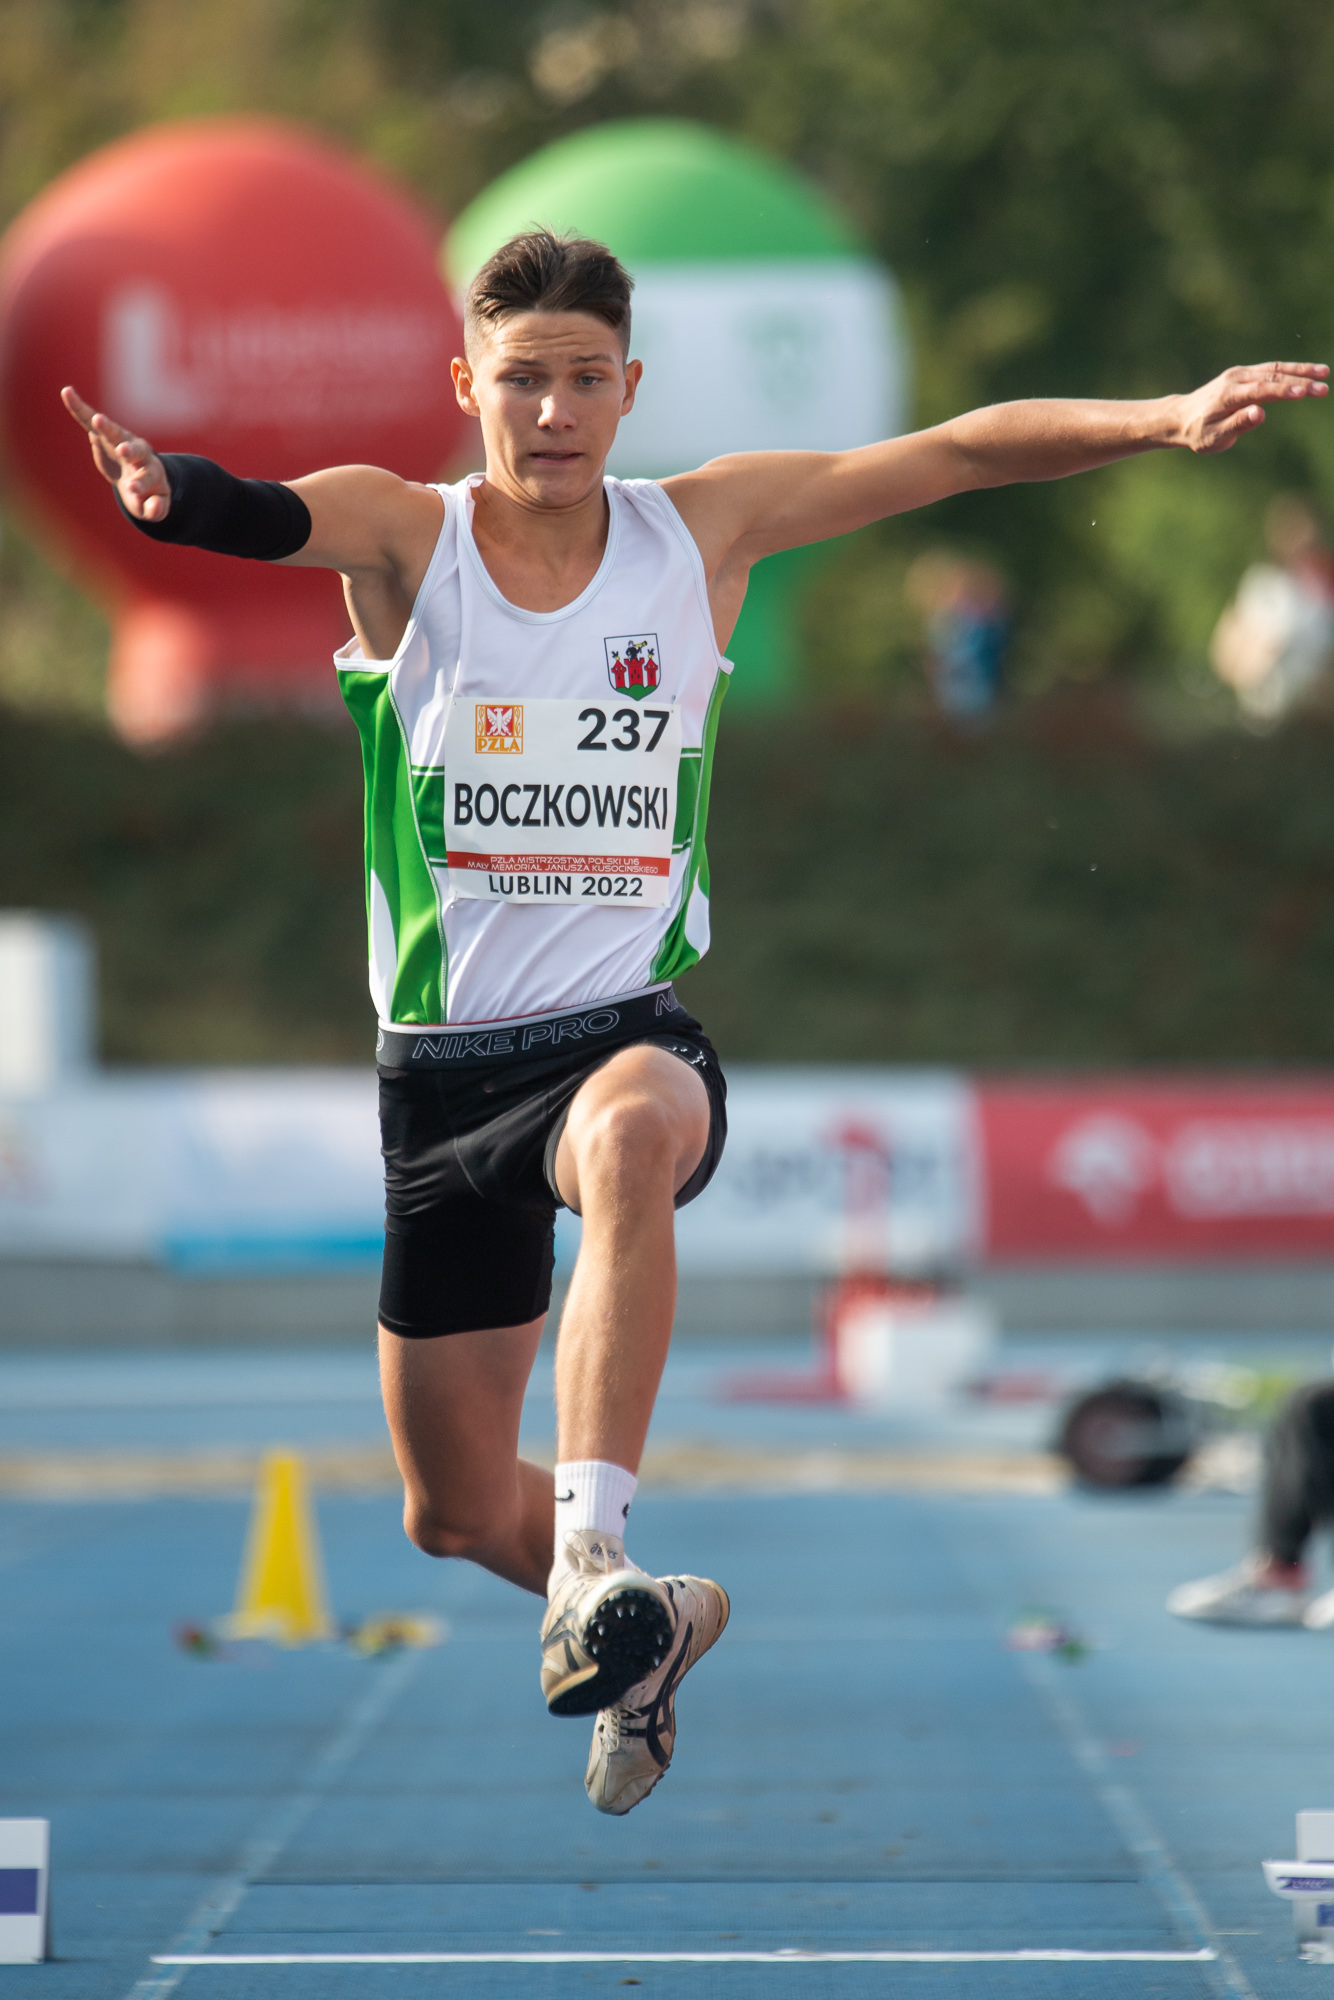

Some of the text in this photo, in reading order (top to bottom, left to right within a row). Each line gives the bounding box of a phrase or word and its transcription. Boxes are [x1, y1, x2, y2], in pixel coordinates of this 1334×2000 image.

[577, 708, 670, 753] 237
[478, 738, 520, 751] PZLA
[454, 783, 668, 830] BOCZKOWSKI
[490, 856, 640, 866] PZLA MISTRZOSTWA POLSKI U16
[544, 864, 591, 872] JANUSZA
[488, 875, 643, 897] LUBLIN 2022
[412, 1030, 516, 1059] NIKE
[522, 1009, 620, 1050] PRO
